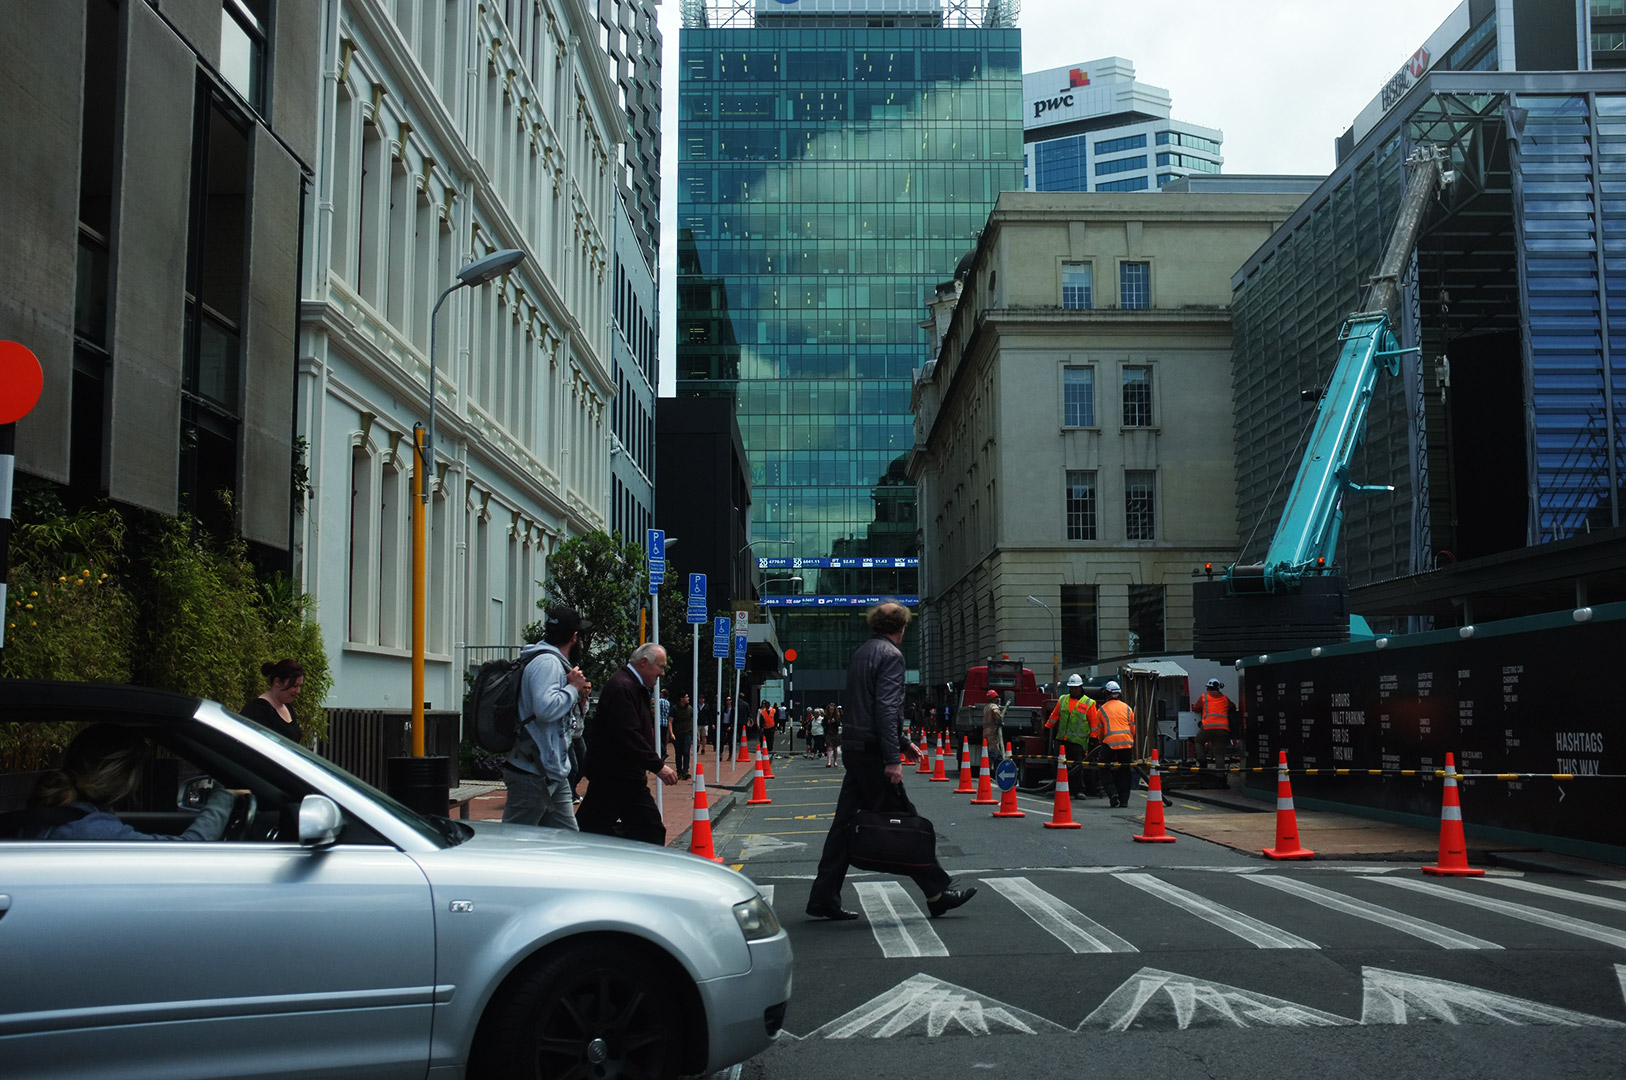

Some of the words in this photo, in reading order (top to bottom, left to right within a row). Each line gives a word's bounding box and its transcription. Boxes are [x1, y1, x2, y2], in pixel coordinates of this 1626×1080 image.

[1381, 64, 1411, 112] HSBC
[1033, 95, 1074, 118] pwc
[653, 532, 659, 542] P
[1502, 666, 1516, 674] ELECTRIC
[1331, 693, 1334, 707] 3
[1335, 693, 1350, 707] HOURS
[1332, 711, 1344, 725] VALET
[1345, 711, 1365, 725] PARKING
[1332, 729, 1341, 742] FOR
[1556, 732, 1604, 752] HASHTAGS
[1333, 746, 1343, 760] THIS
[1343, 746, 1353, 760] WAY
[1557, 758, 1577, 775] THIS
[1580, 760, 1599, 776] WAY
